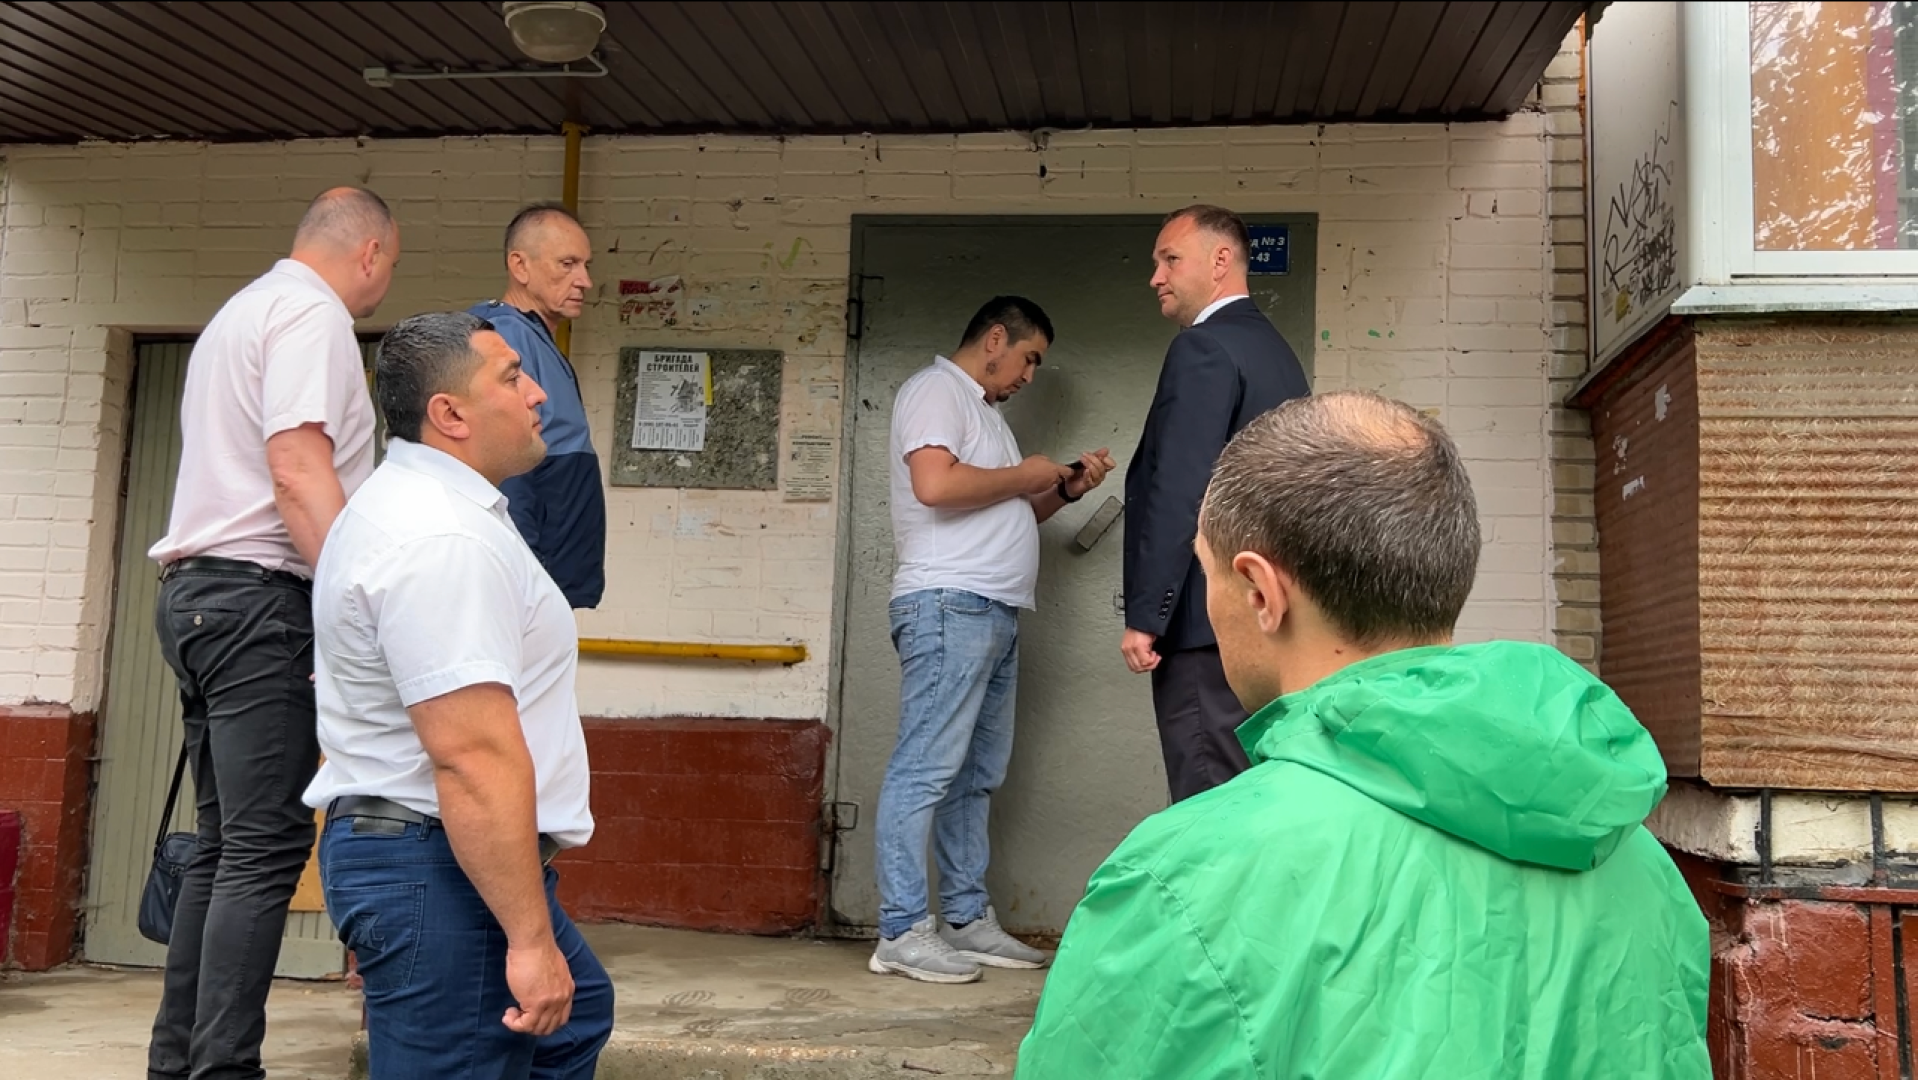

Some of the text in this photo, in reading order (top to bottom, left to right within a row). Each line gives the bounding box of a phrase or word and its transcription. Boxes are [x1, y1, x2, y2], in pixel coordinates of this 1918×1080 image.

[1276, 236, 1285, 246] 3
[1256, 252, 1270, 262] 43
[654, 354, 694, 364] БРИГАДА
[646, 363, 700, 372] СТРОИТЕЛЕЙ
